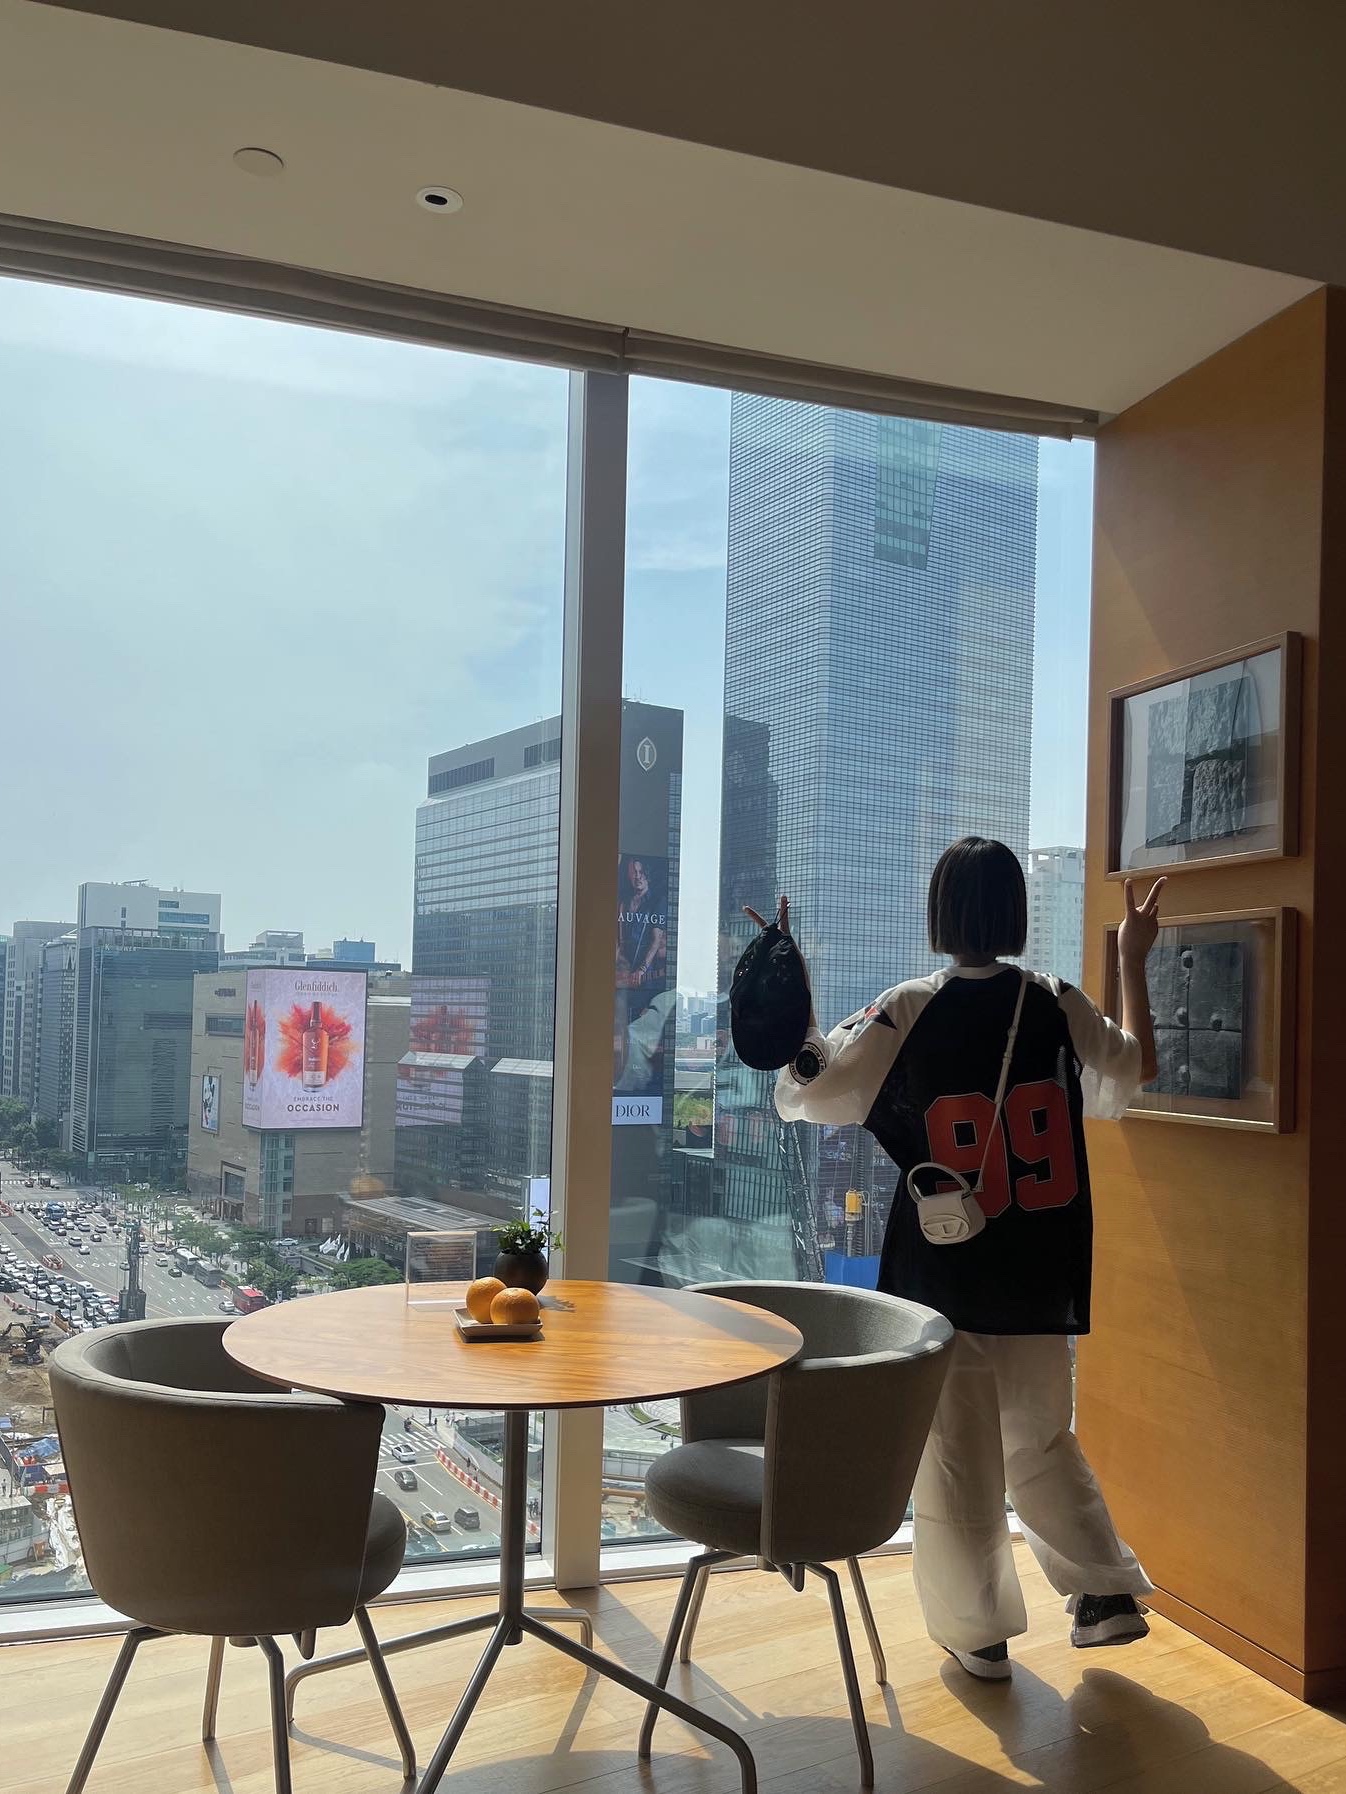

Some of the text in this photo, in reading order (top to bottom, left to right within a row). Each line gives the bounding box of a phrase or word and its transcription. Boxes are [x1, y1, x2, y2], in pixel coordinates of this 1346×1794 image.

[617, 912, 666, 925] AUVAGE
[294, 980, 338, 992] Glenfiddich
[287, 1104, 340, 1112] OCCASION
[616, 1104, 650, 1117] DIOR
[925, 1079, 1078, 1218] 99
